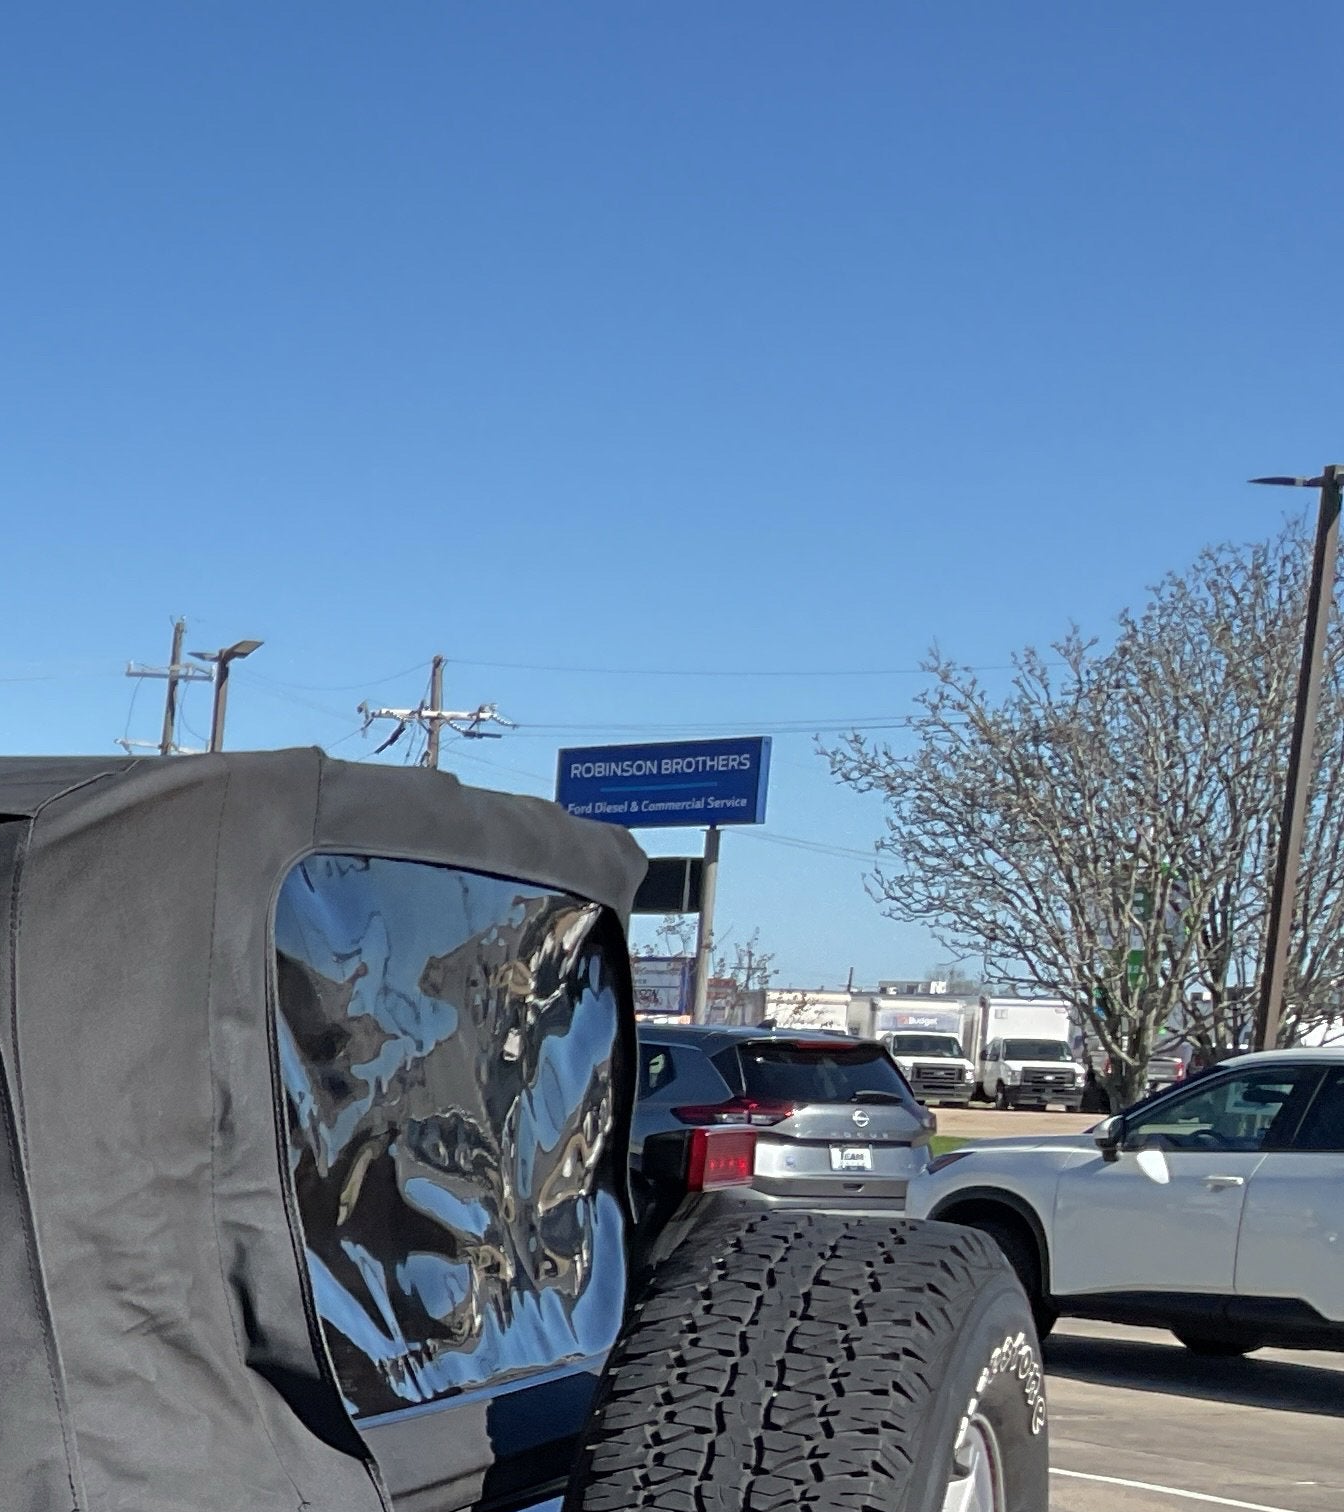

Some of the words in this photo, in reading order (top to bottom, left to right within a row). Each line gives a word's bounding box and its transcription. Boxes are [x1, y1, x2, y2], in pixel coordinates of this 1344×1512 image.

[570, 760, 657, 779] ROBINSON
[662, 753, 751, 774] BROTHERS
[567, 802, 593, 816] Ford
[594, 801, 628, 814] Diesel
[629, 801, 639, 812] &
[641, 797, 705, 812] Commercial
[706, 795, 748, 809] Service
[908, 1015, 938, 1027] Budget
